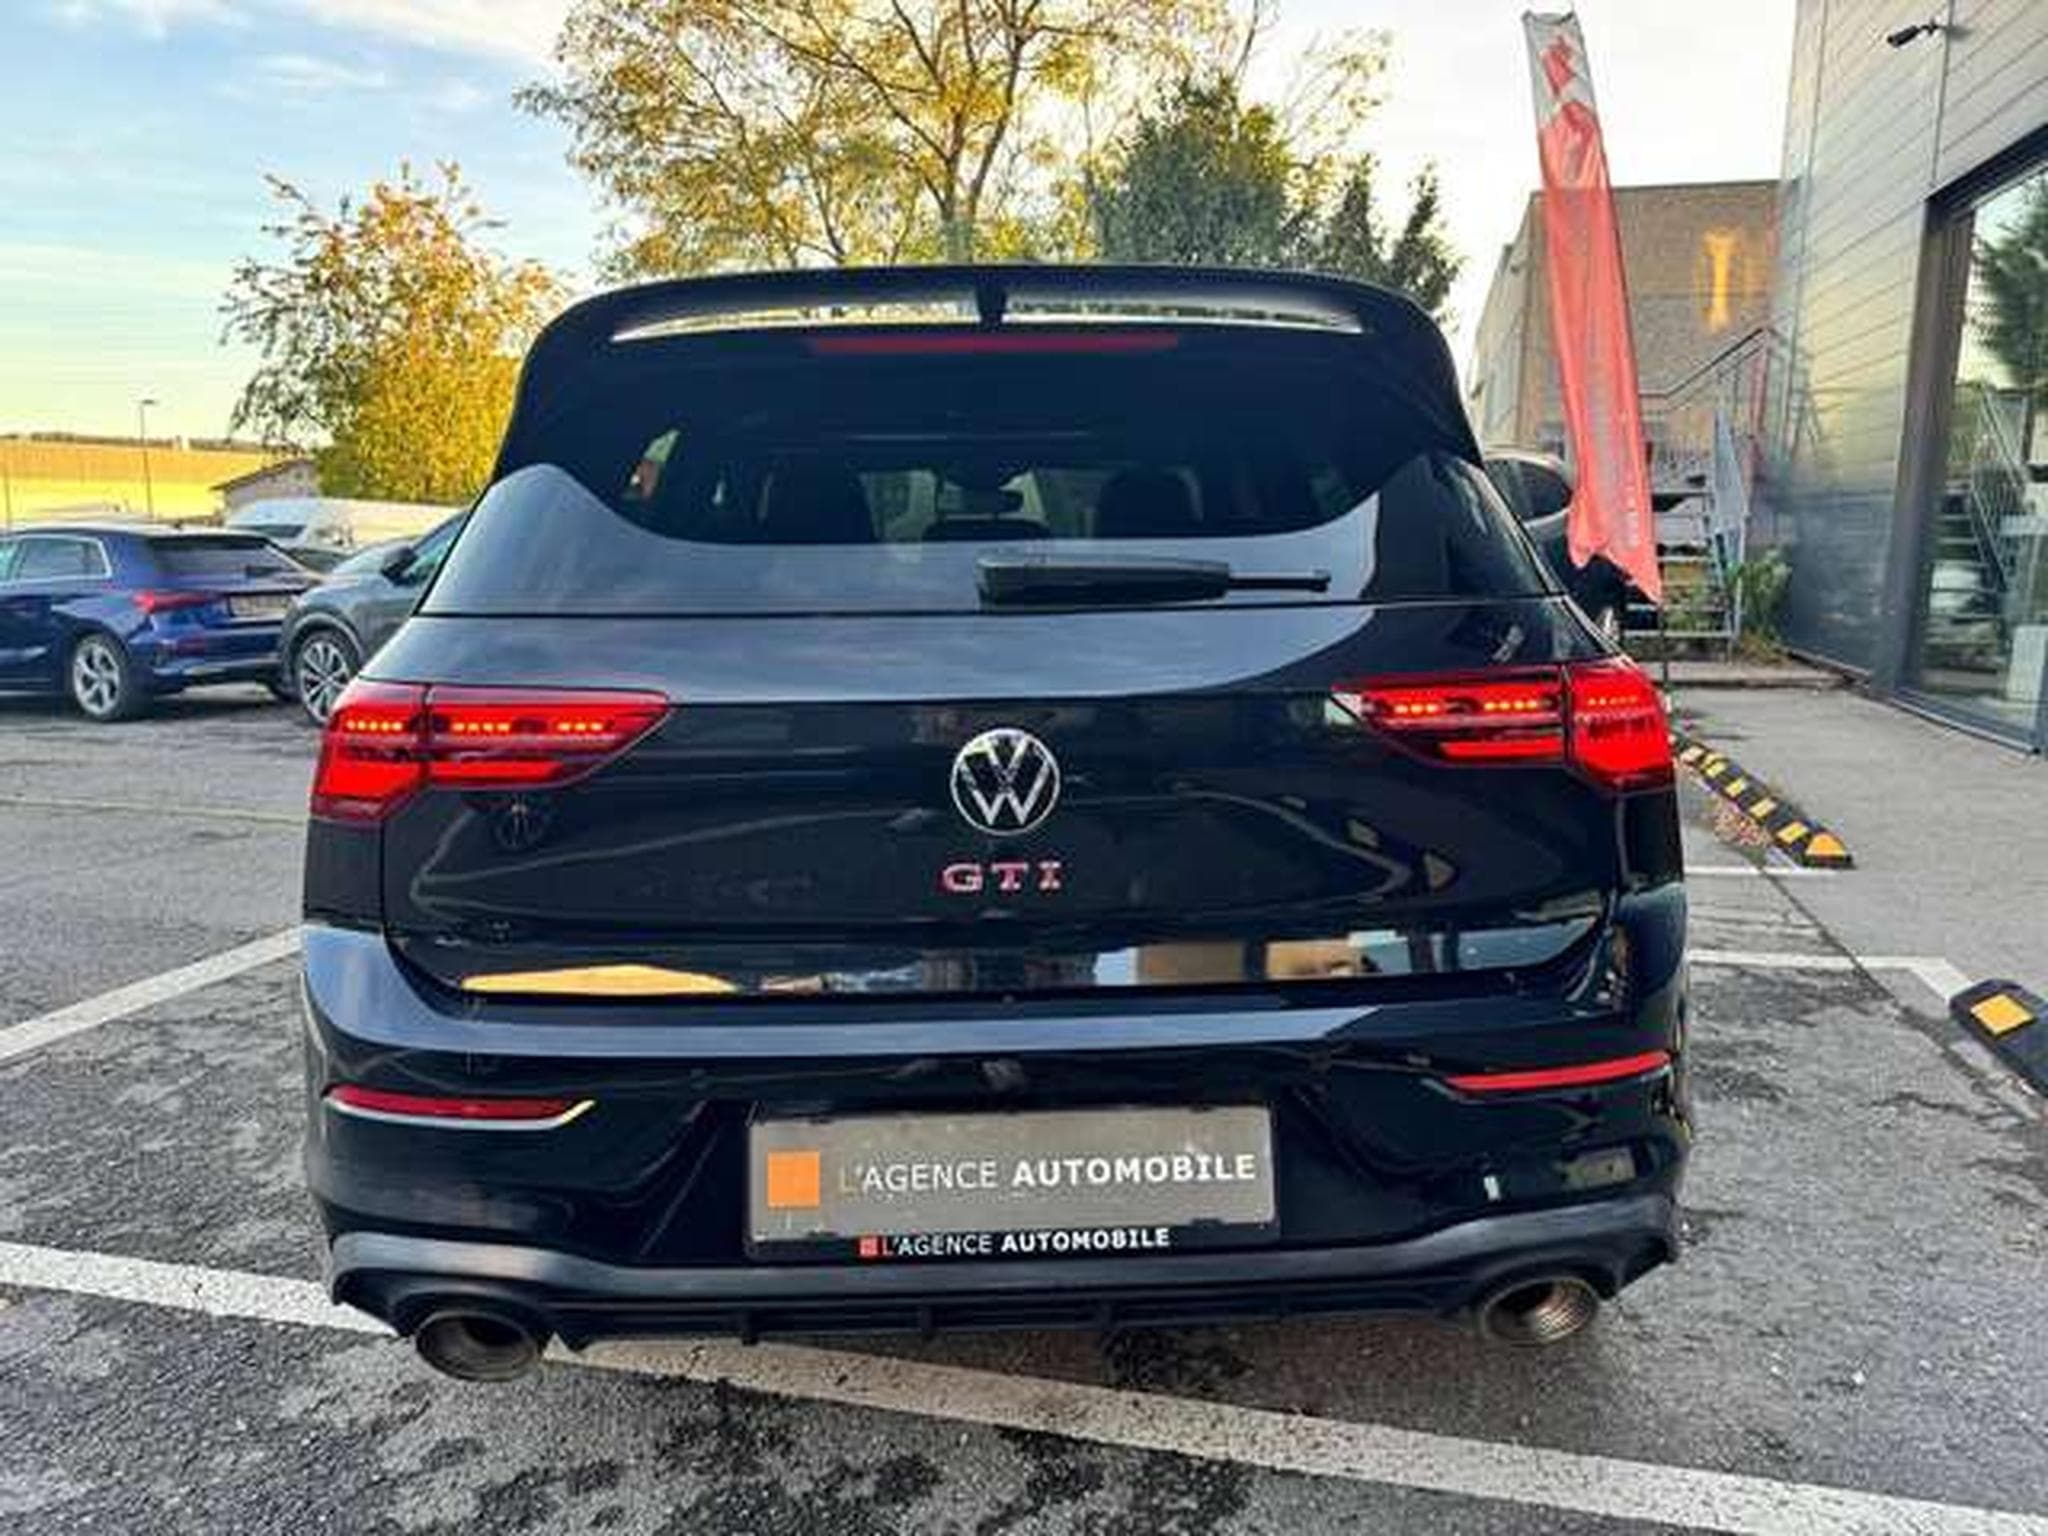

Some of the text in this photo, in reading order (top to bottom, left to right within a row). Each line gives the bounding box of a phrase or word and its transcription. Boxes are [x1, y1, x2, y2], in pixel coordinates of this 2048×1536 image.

[954, 730, 1058, 834] VW
[941, 860, 1062, 891] GTI
[839, 1153, 1257, 1193] L'AGENCE AUTOMOBILE
[882, 1228, 1170, 1257] L'AGENCE AUTOMOBILE
